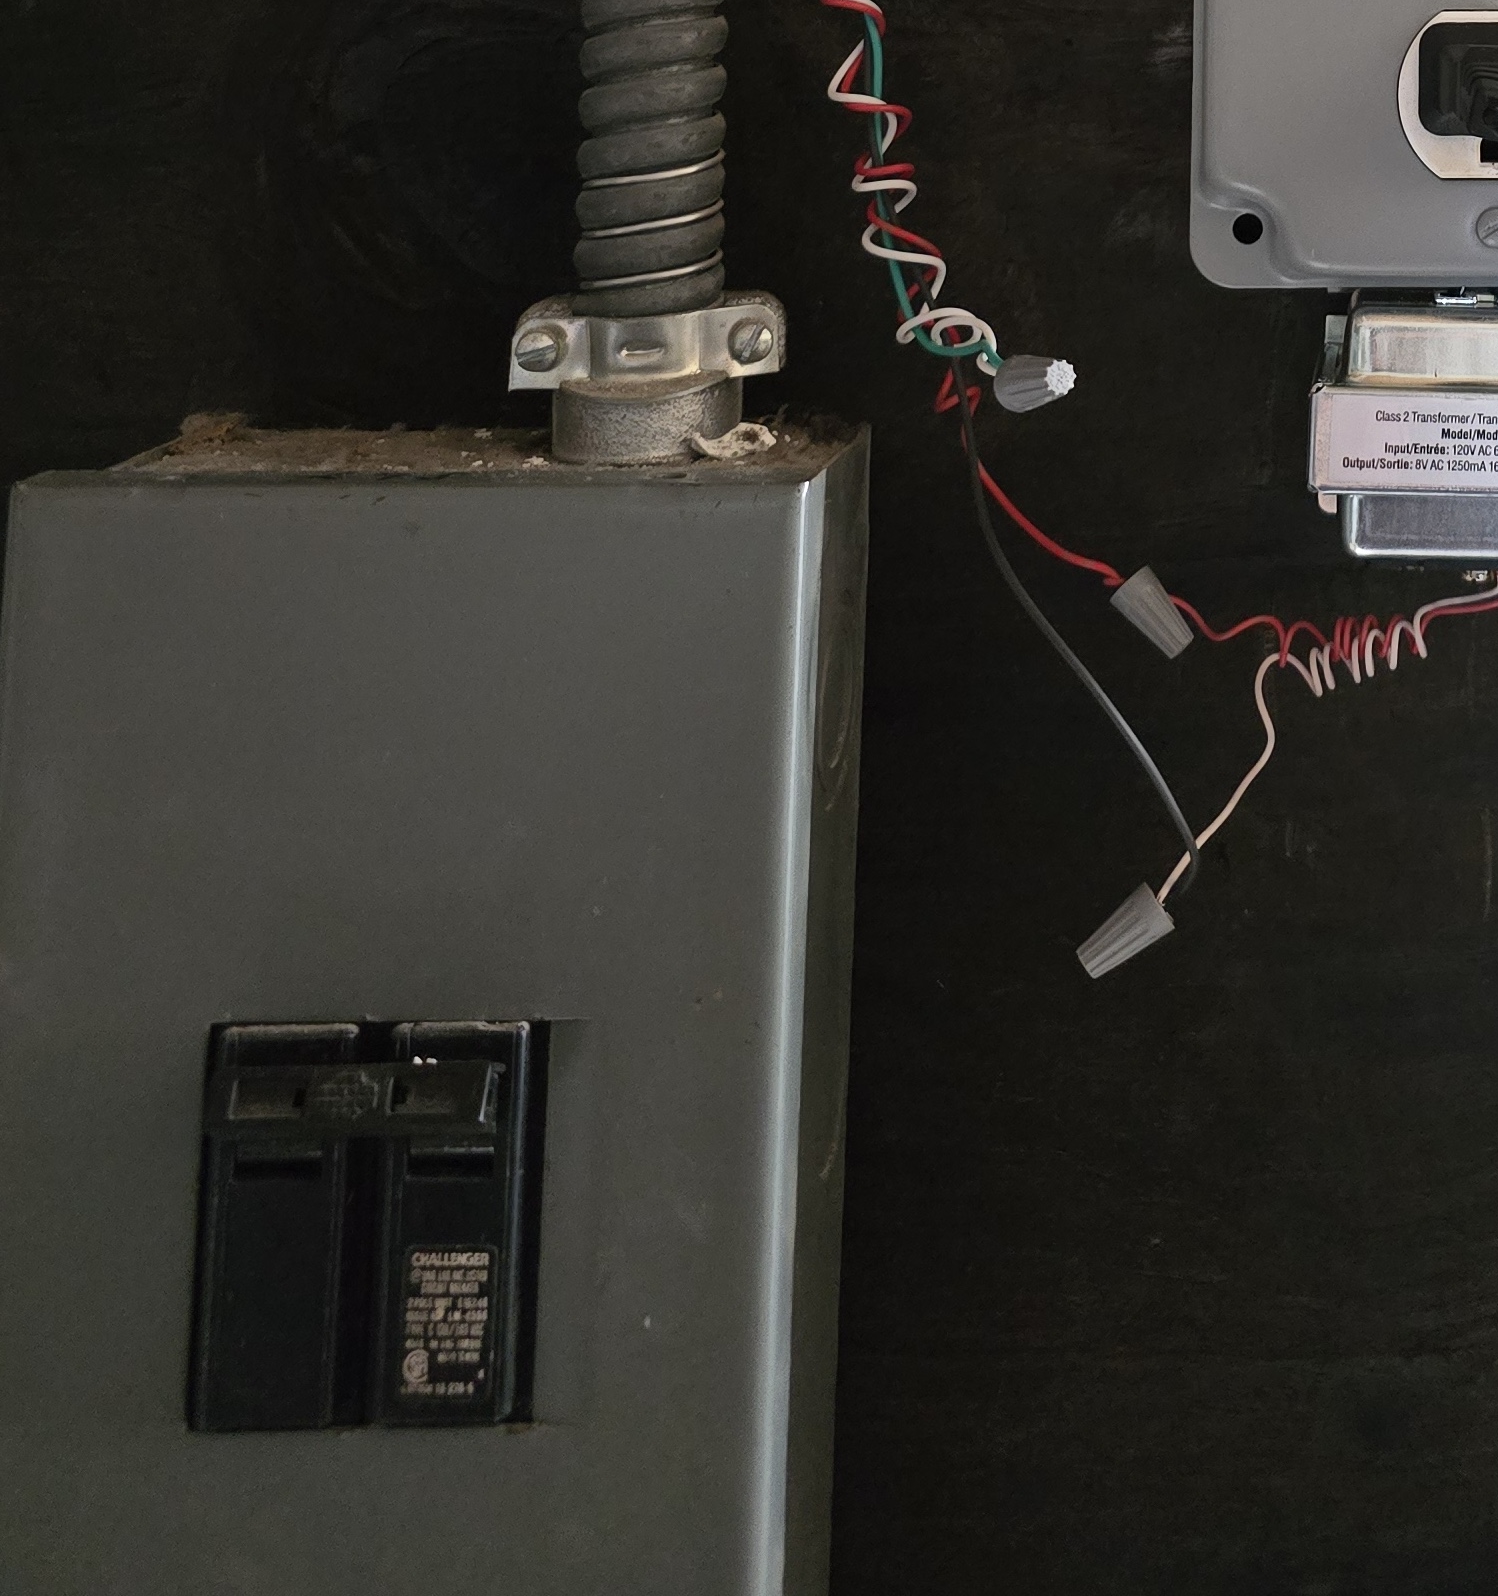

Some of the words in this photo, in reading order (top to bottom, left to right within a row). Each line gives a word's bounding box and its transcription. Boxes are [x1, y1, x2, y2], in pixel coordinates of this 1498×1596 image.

[1375, 410, 1401, 424] Class
[1402, 411, 1410, 424] 2
[1411, 412, 1470, 426] Transformer
[1471, 412, 1477, 426] /
[1384, 442, 1450, 457] Input/Entrée:
[1452, 444, 1477, 456] 120V
[1477, 445, 1492, 457] AC
[1342, 456, 1414, 471] Output/Sortie:
[1415, 459, 1428, 471] 8V
[1429, 459, 1444, 471] AC
[1446, 459, 1487, 473] 1250mA
[411, 1252, 490, 1267] CHALLENGER
